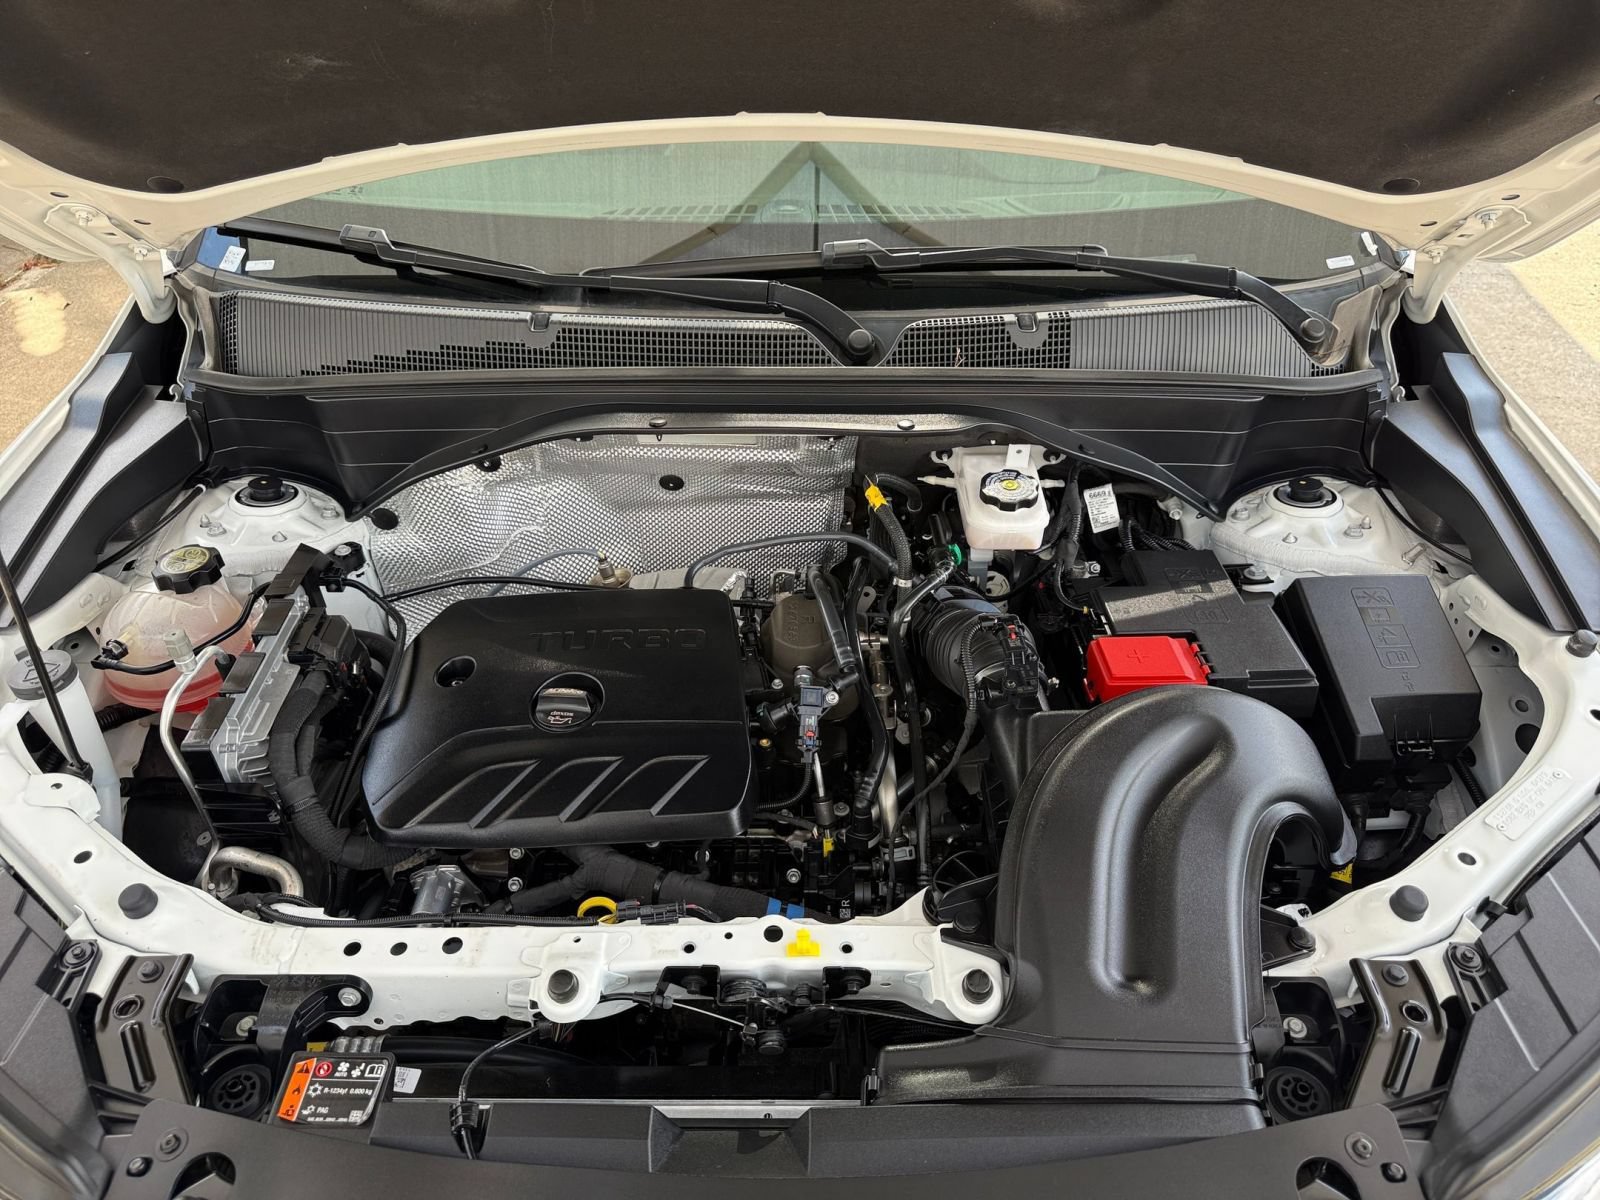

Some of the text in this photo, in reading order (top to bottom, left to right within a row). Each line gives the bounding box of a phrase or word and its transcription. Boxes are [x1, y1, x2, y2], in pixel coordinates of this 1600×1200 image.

[528, 628, 707, 652] TURBO
[365, 1087, 373, 1096] kg
[316, 1106, 329, 1114] PAG
